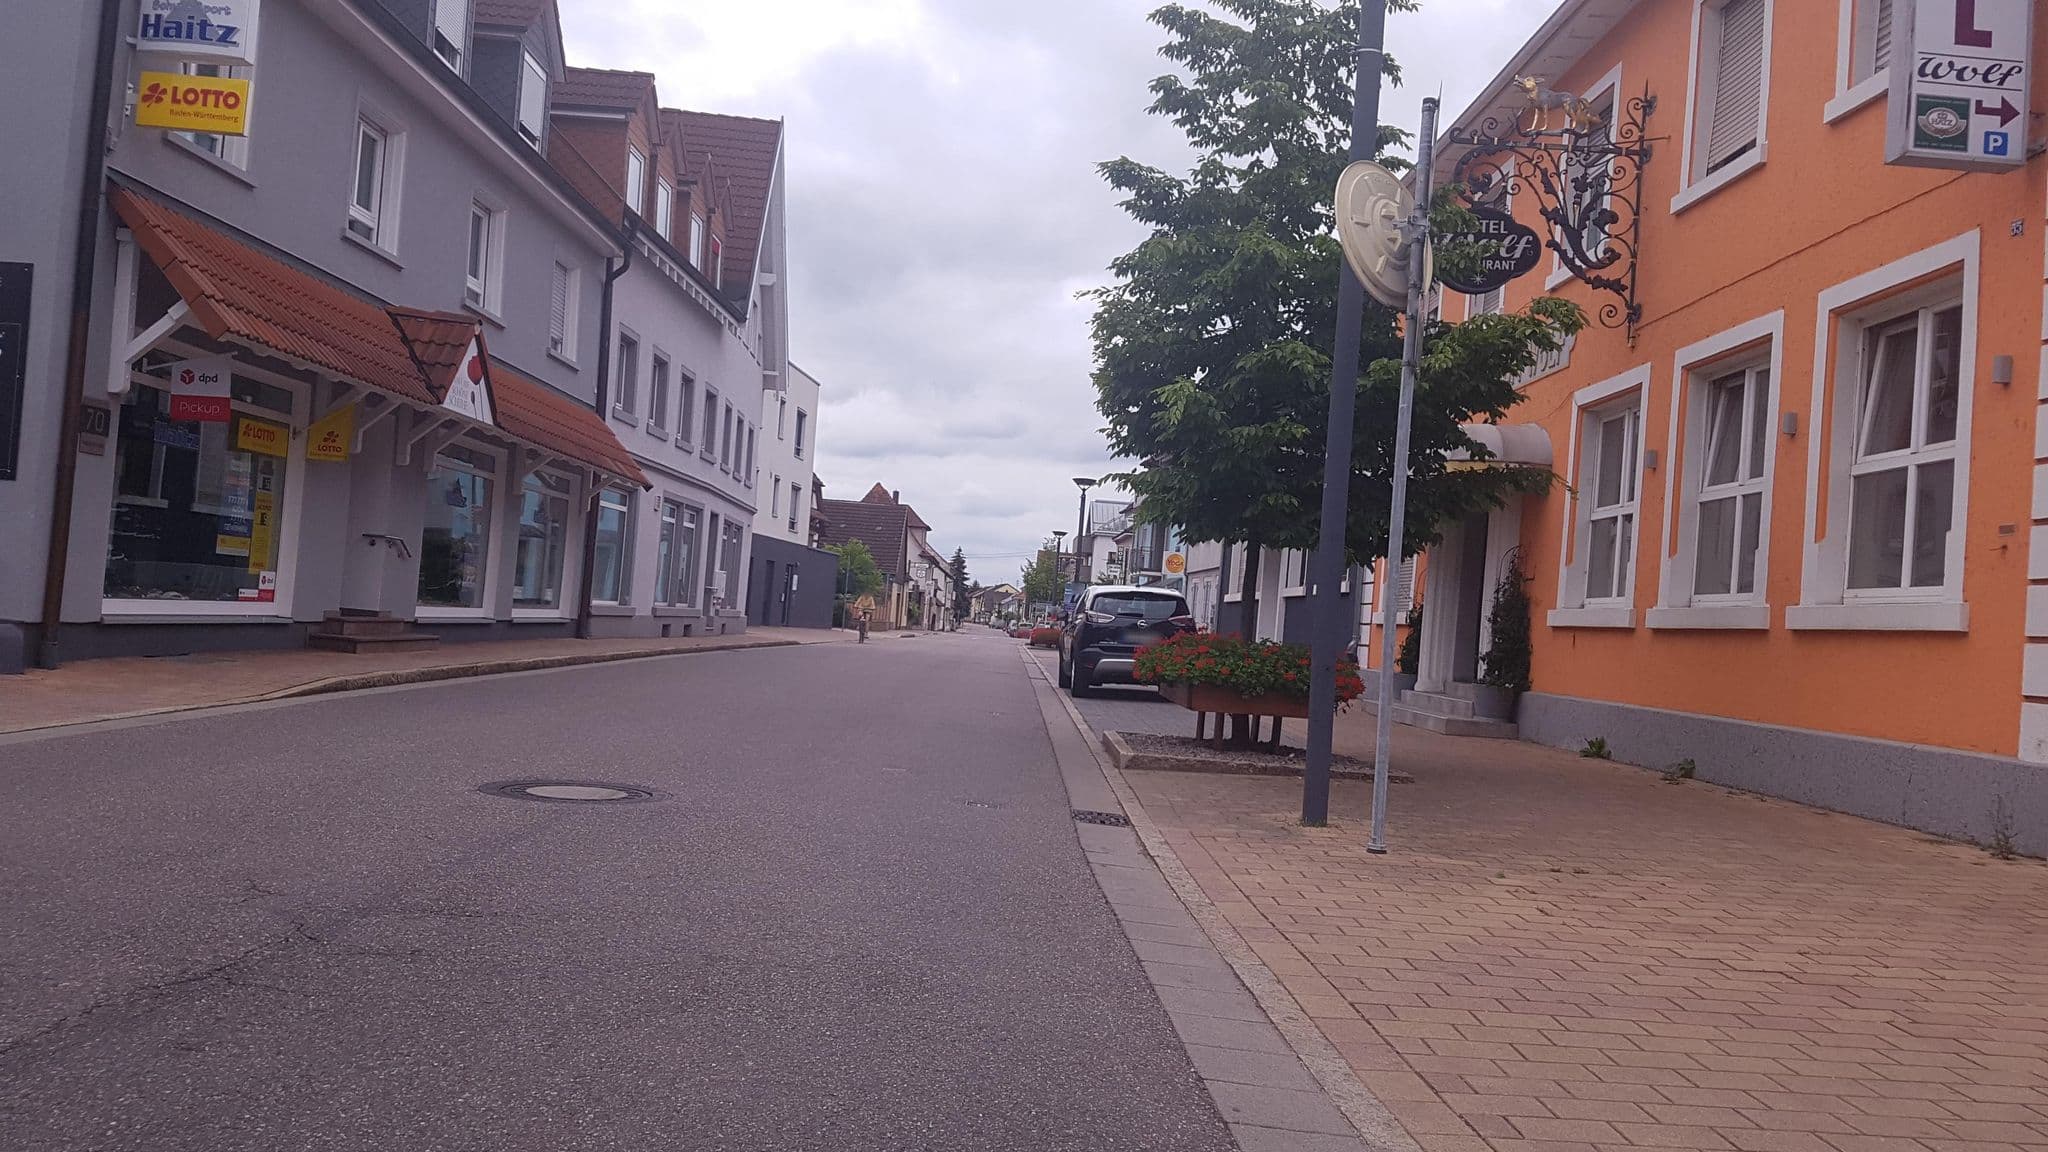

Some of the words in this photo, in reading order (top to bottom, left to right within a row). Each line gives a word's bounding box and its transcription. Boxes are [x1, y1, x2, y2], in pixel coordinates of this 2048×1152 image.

[140, 13, 241, 45] Haitz
[171, 86, 241, 110] LOTTO
[1987, 134, 2003, 152] P
[198, 372, 218, 385] dpd
[180, 401, 220, 416] Pickup
[86, 408, 105, 432] 70
[252, 425, 275, 442] LOTTO
[317, 444, 343, 453] LOTTO
